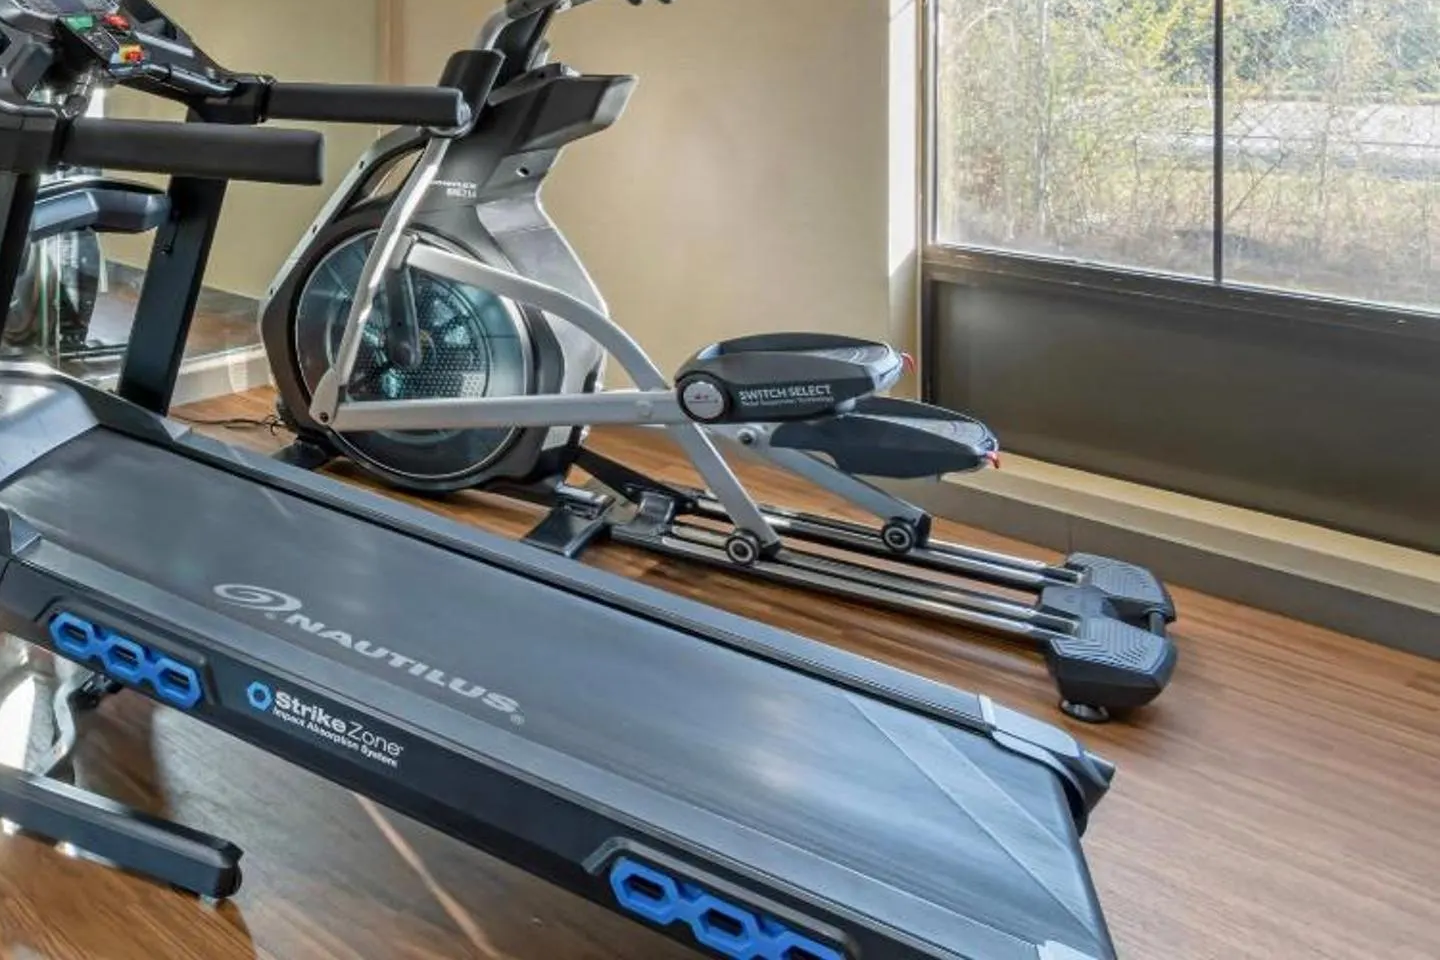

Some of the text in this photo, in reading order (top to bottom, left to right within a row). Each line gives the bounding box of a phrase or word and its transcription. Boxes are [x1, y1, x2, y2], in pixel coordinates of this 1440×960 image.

[739, 384, 831, 401] SWITCH SELECT
[285, 614, 520, 713] NAUTILUS
[272, 707, 398, 768] Impact Absorption System
